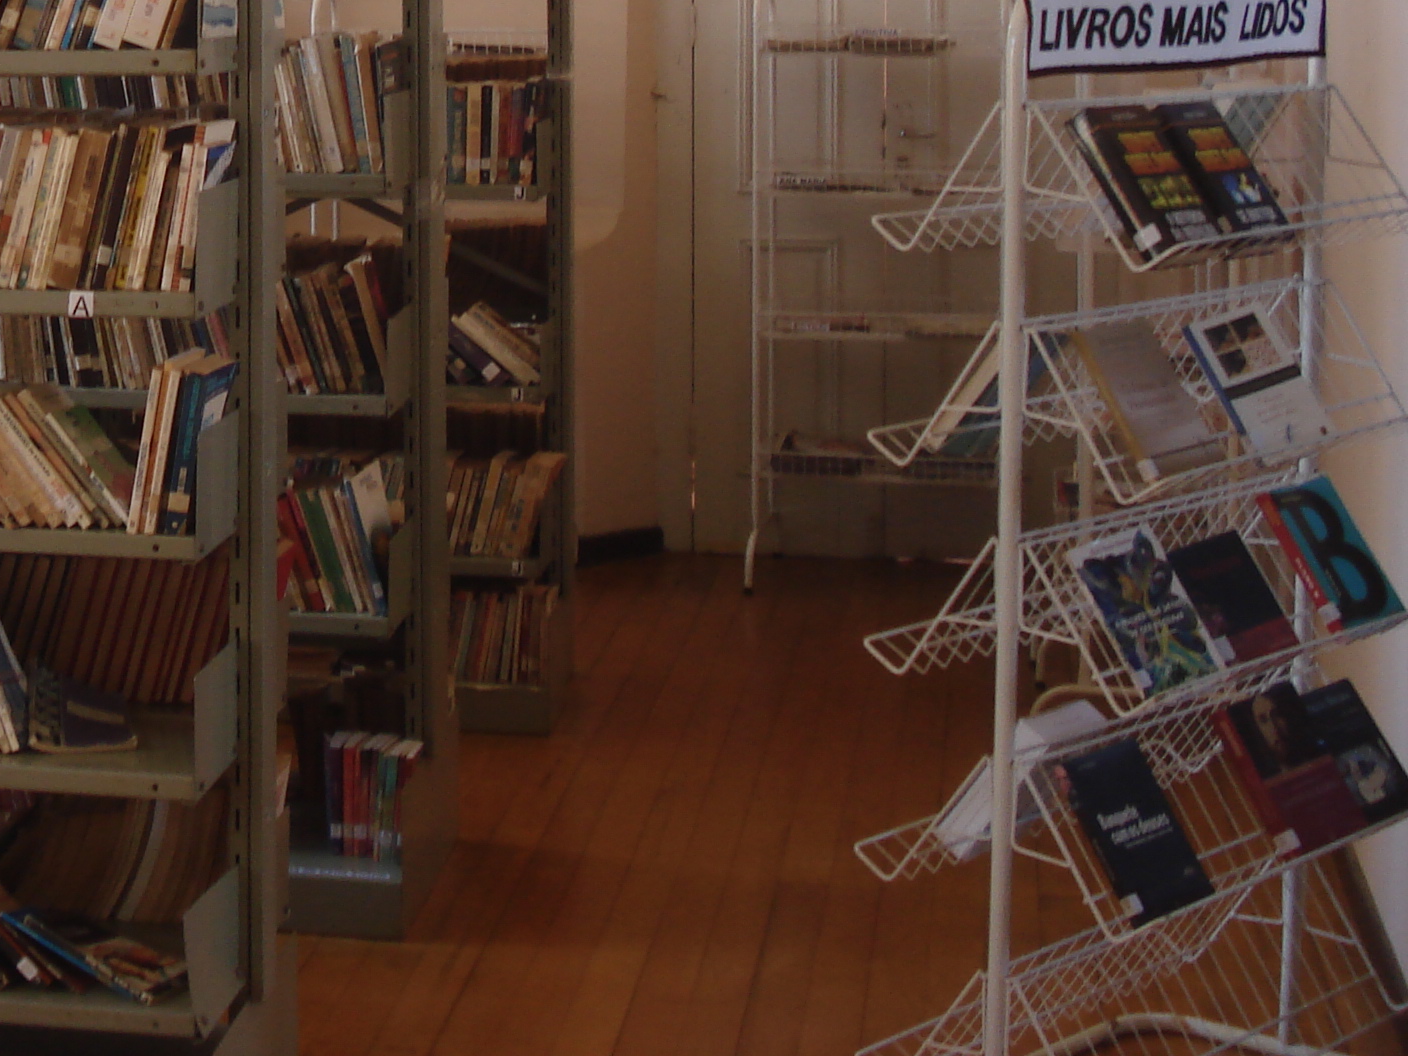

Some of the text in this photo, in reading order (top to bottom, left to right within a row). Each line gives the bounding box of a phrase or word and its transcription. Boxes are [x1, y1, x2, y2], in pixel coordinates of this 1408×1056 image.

[1039, 3, 1154, 52] LIVROS
[1159, 1, 1229, 47] MAIS
[72, 296, 90, 317] A
[1270, 490, 1388, 622] B
